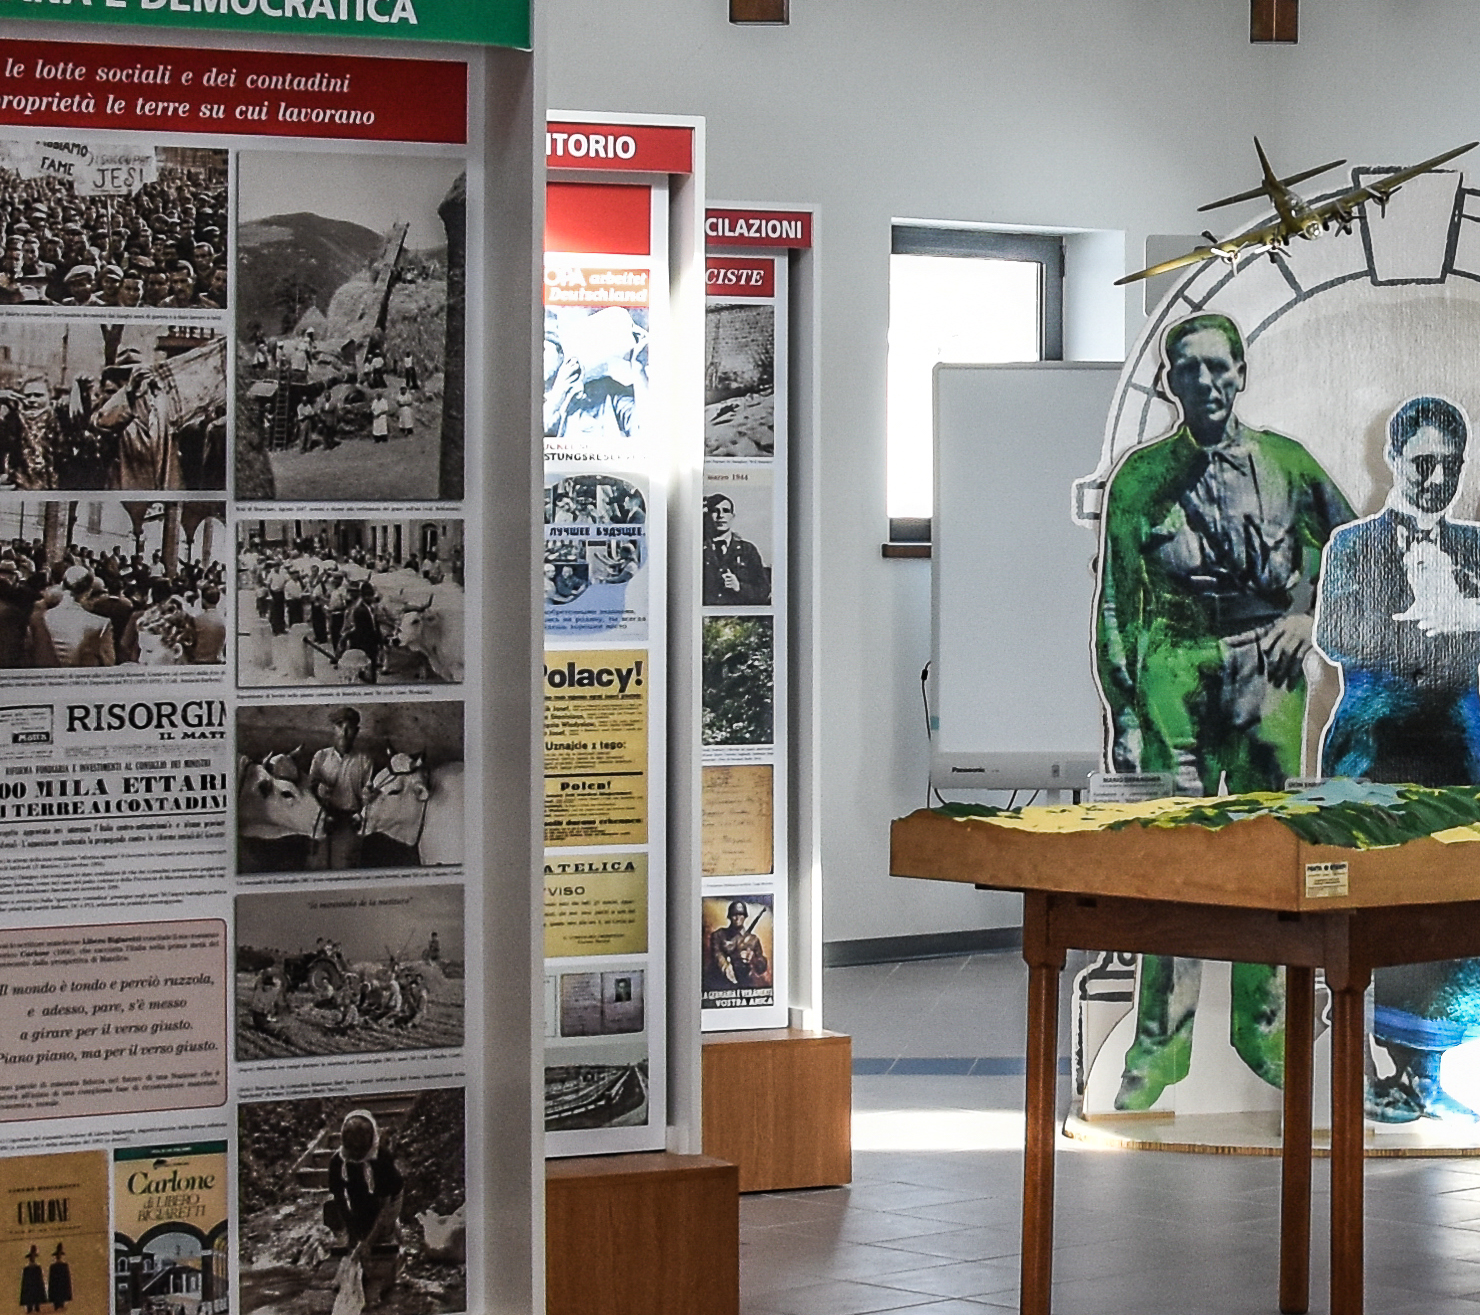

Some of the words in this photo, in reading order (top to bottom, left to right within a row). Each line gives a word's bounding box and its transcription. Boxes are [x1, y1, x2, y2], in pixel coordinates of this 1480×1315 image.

[5, 57, 25, 78] le
[35, 59, 86, 80] lotte
[95, 63, 172, 85] sociali
[181, 71, 193, 85] e
[202, 67, 236, 87] dei
[245, 72, 350, 92] contadini
[106, 94, 125, 114] le
[135, 97, 190, 117] terre
[199, 104, 224, 118] su
[235, 101, 268, 120] cui
[278, 101, 375, 125] lavorano
[705, 218, 802, 239] CILAZIONI
[706, 269, 764, 285] CISTE
[544, 660, 643, 693] olacy!
[35, 778, 108, 798] MILA
[12, 981, 56, 995] mondo
[59, 980, 67, 993] è
[70, 978, 107, 992] tondo
[109, 980, 117, 990] e
[119, 975, 160, 992] perciò
[163, 972, 215, 986] ruzzola,
[127, 1169, 214, 1196] Carlone
